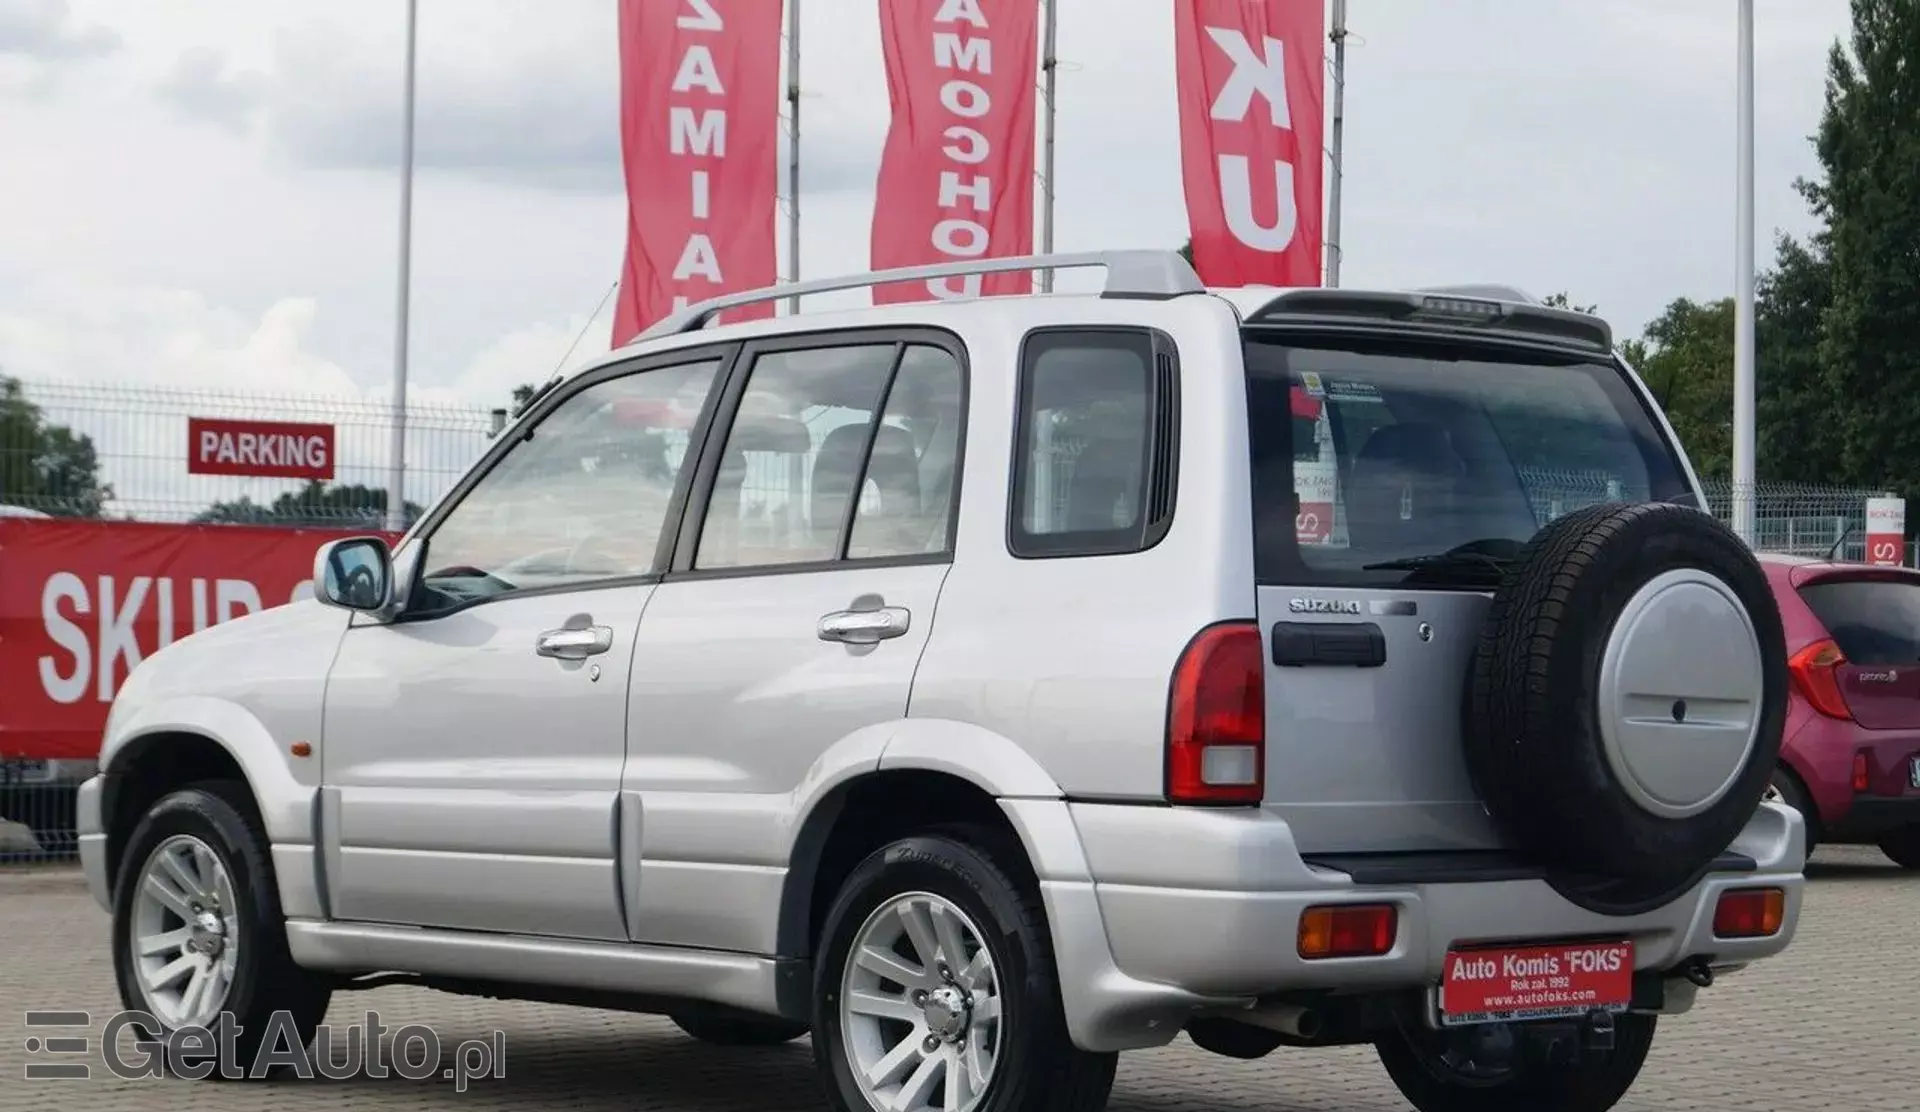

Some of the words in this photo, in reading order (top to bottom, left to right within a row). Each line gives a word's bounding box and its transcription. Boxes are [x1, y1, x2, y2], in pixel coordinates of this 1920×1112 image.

[200, 430, 327, 468] PARKING
[1289, 598, 1360, 614] SUZUKI
[1451, 957, 1496, 981] Auto
[1503, 953, 1559, 977] Komis
[1564, 948, 1628, 974] "FOKS"
[1484, 990, 1596, 1006] www.autofoks.com
